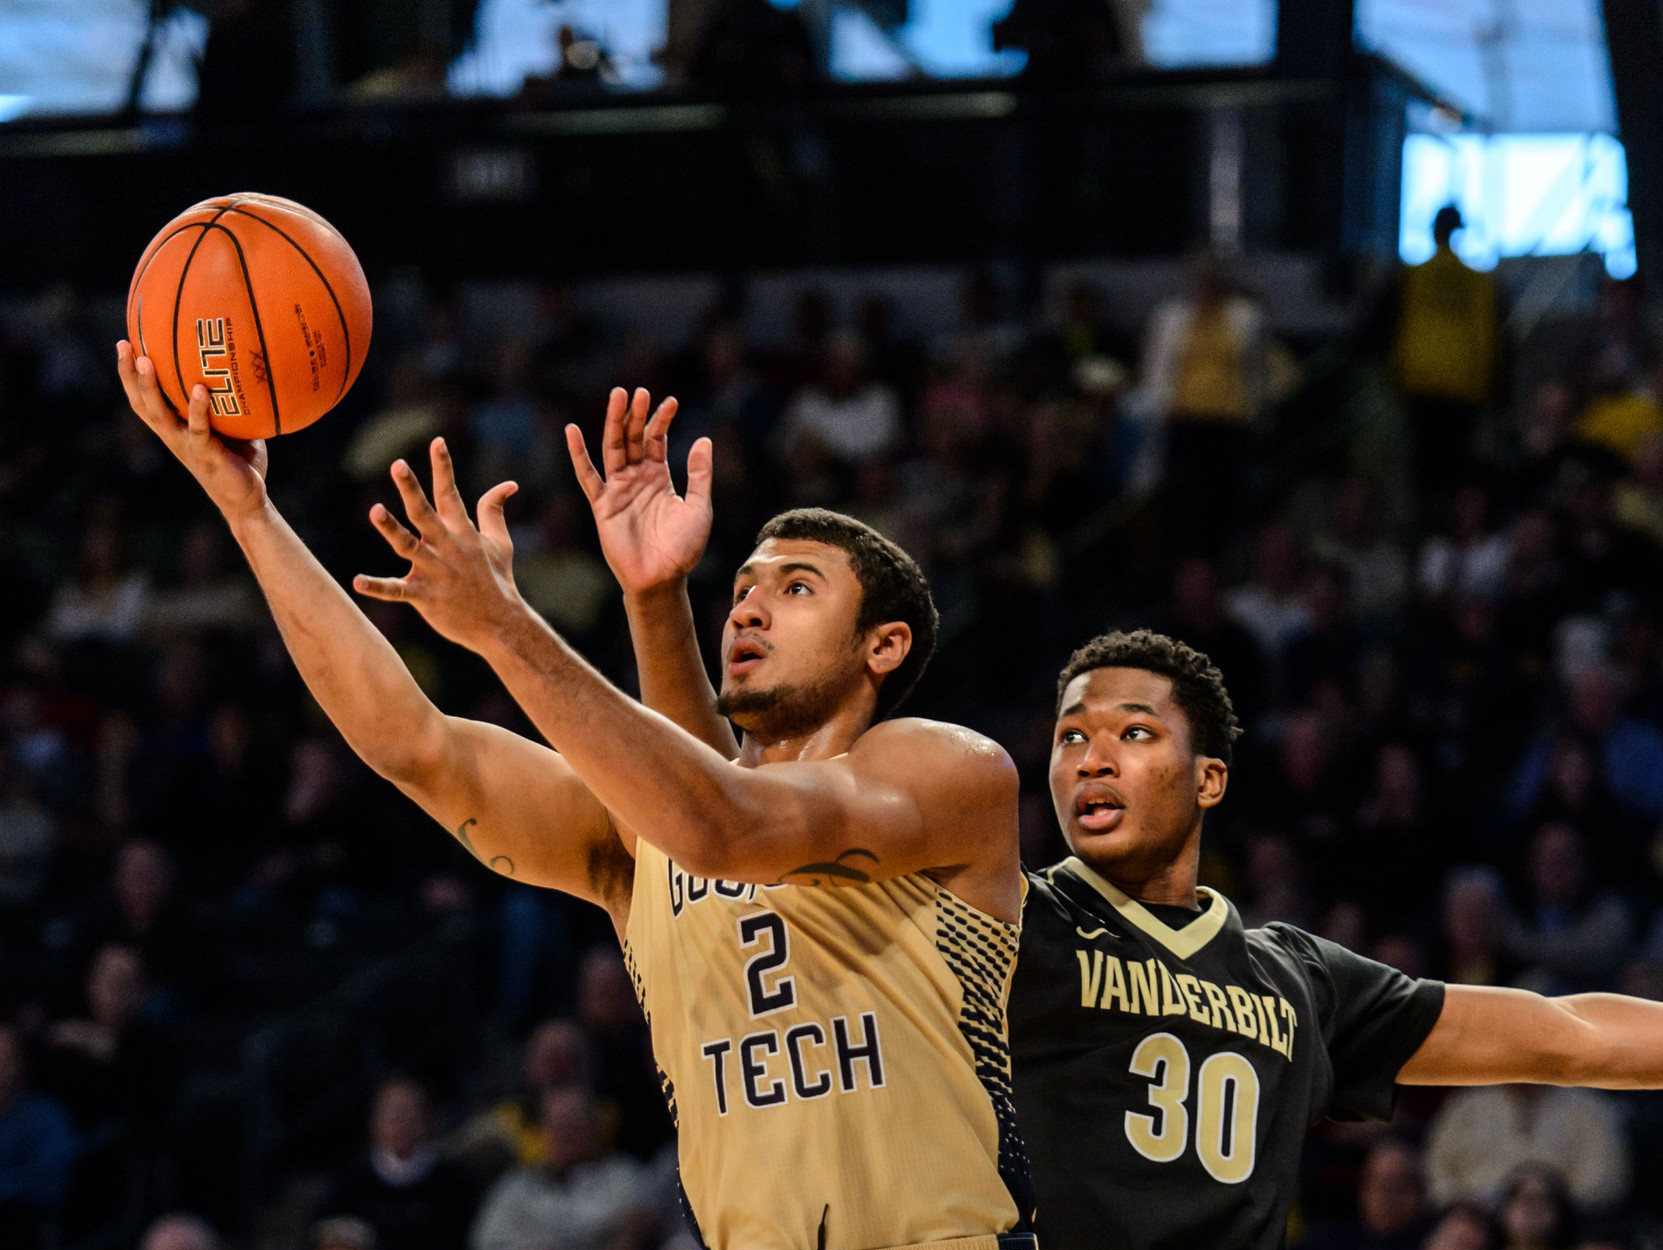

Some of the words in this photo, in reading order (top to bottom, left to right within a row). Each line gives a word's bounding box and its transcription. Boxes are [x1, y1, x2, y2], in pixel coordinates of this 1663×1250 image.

[197, 318, 242, 416] ELITE
[226, 317, 250, 416] CHAMPIONSHIP
[736, 909, 797, 1020] 2
[1076, 949, 1298, 1062] VANDERBILT
[701, 1011, 886, 1117] TECH
[1124, 1032, 1260, 1184] 30
